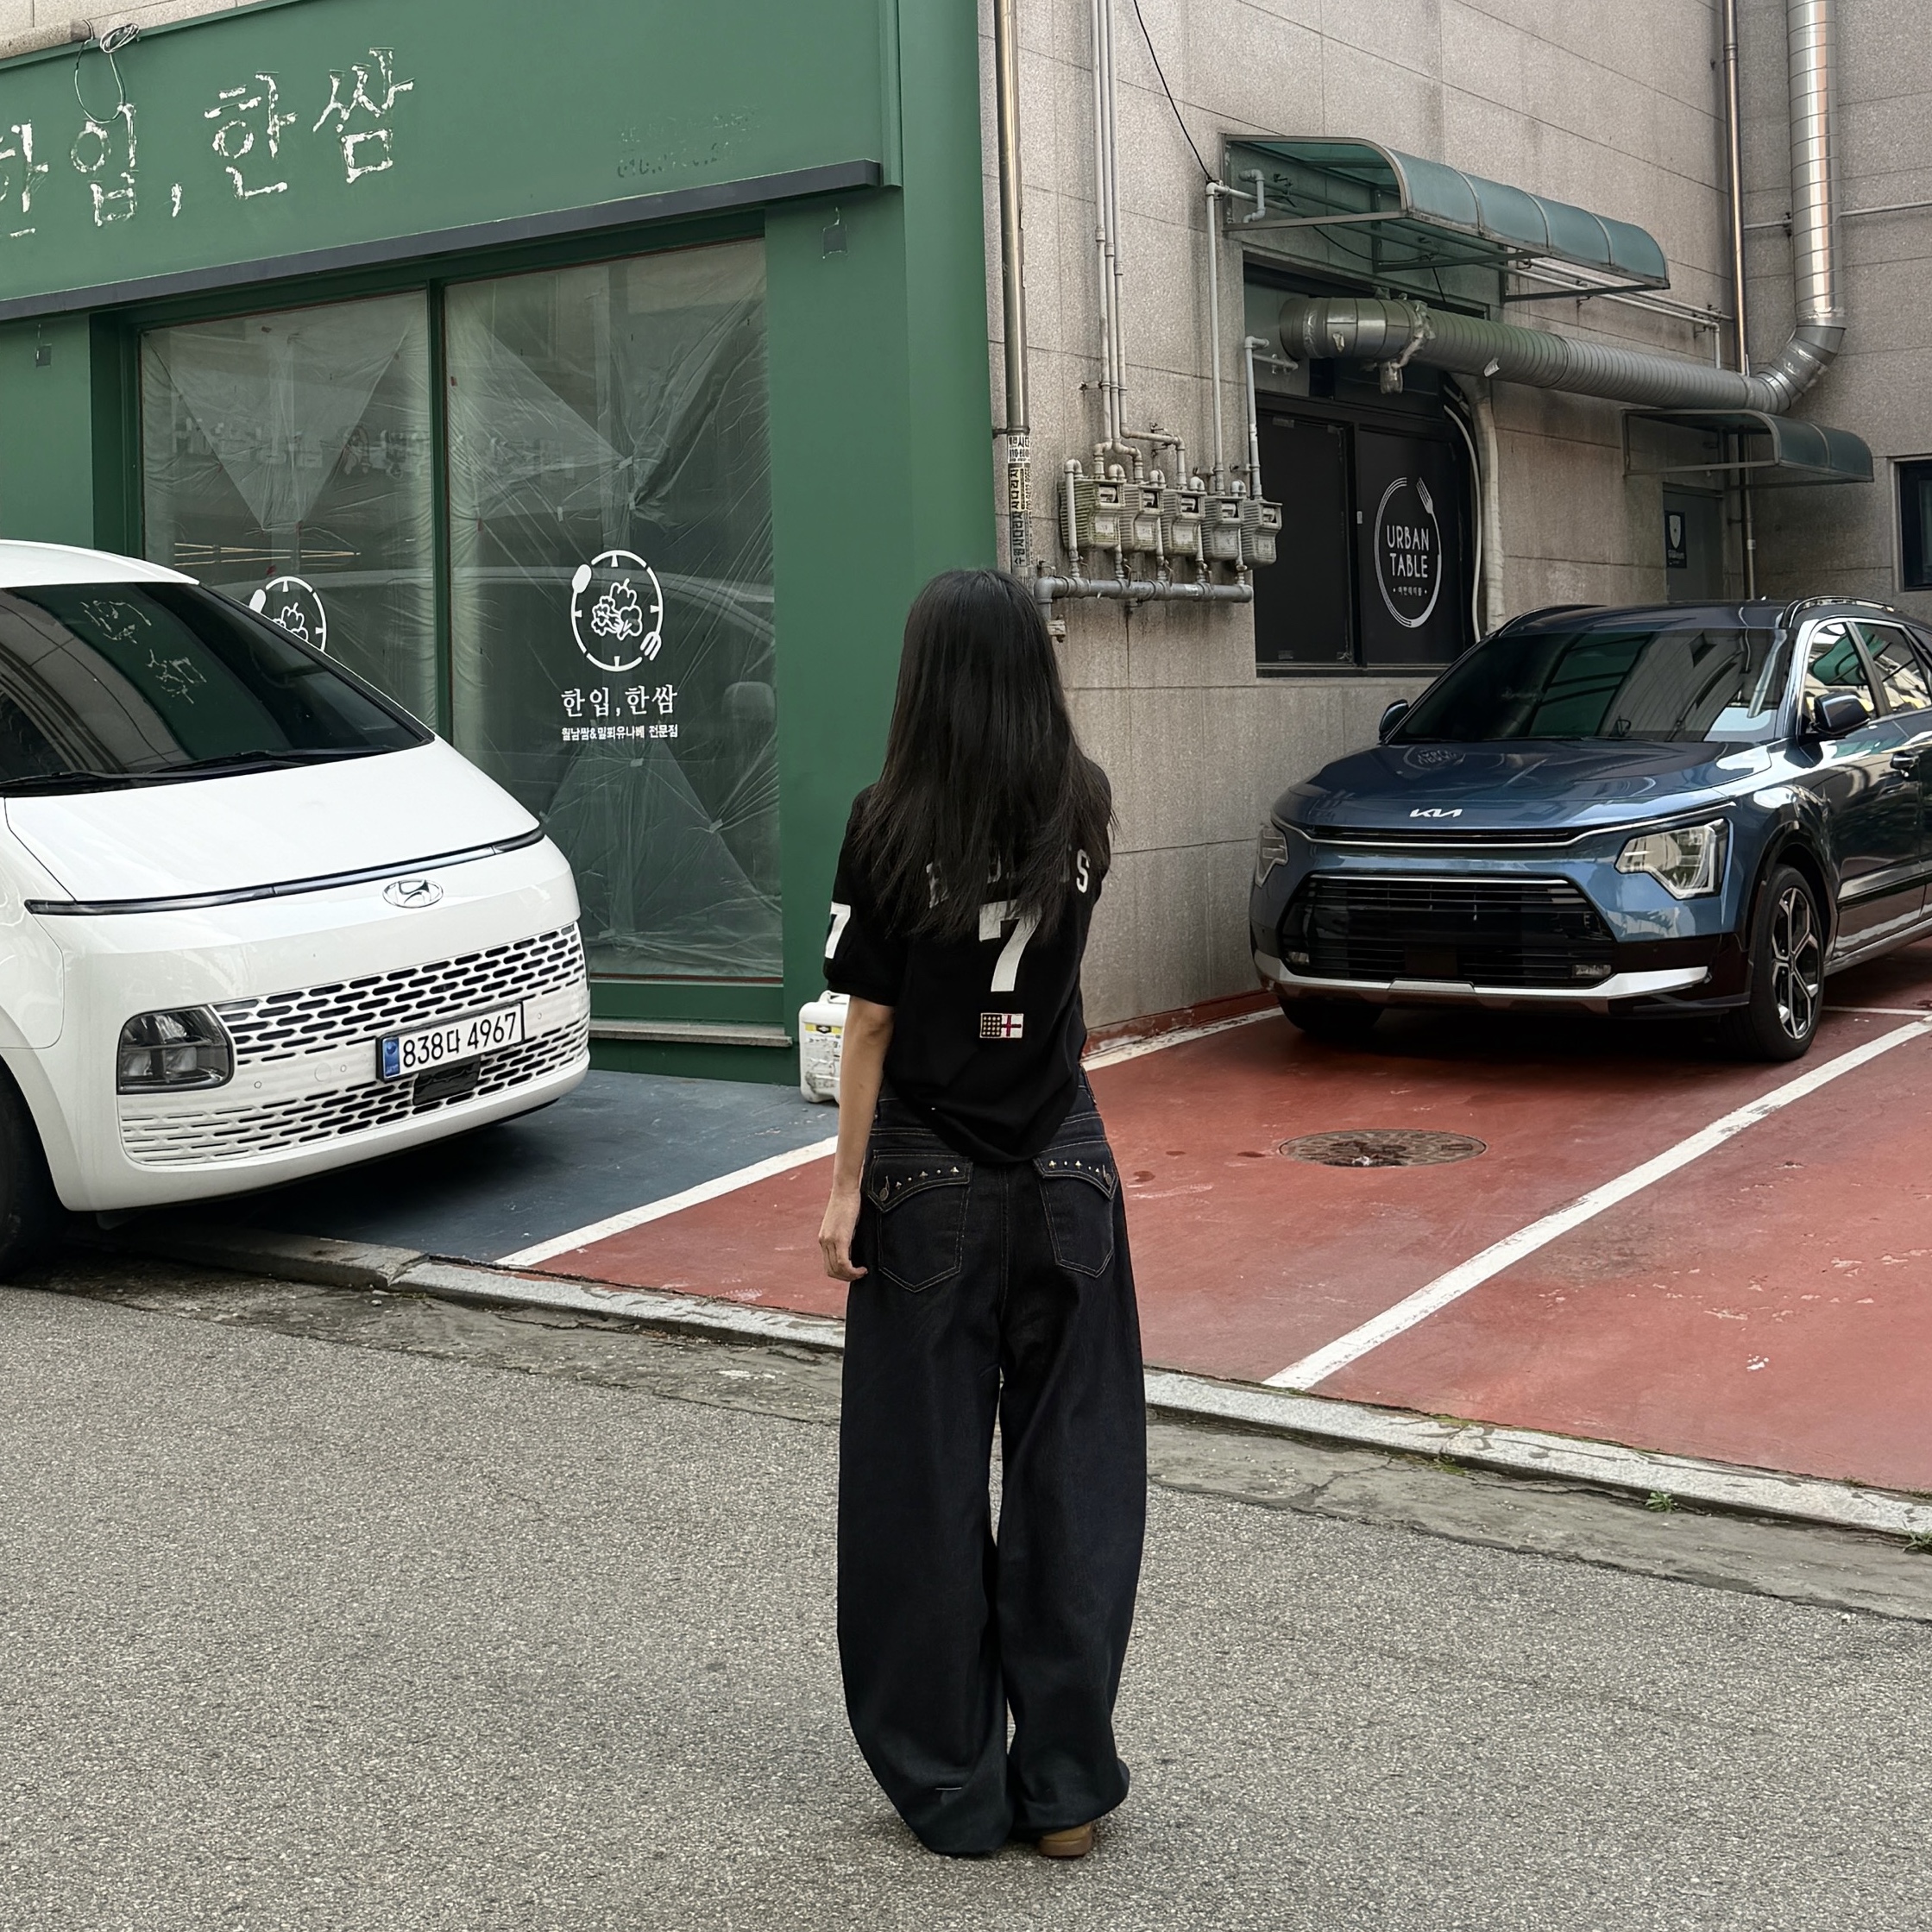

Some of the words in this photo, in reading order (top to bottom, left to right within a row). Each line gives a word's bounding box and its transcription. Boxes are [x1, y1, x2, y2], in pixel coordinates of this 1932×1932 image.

[1387, 525, 1429, 551] URBAN
[1389, 553, 1428, 577] TABLE
[649, 724, 678, 738] 전문점
[1409, 809, 1463, 818] KIA
[825, 902, 851, 960] 7
[979, 899, 1042, 992] 7
[467, 1012, 516, 1049] 4967
